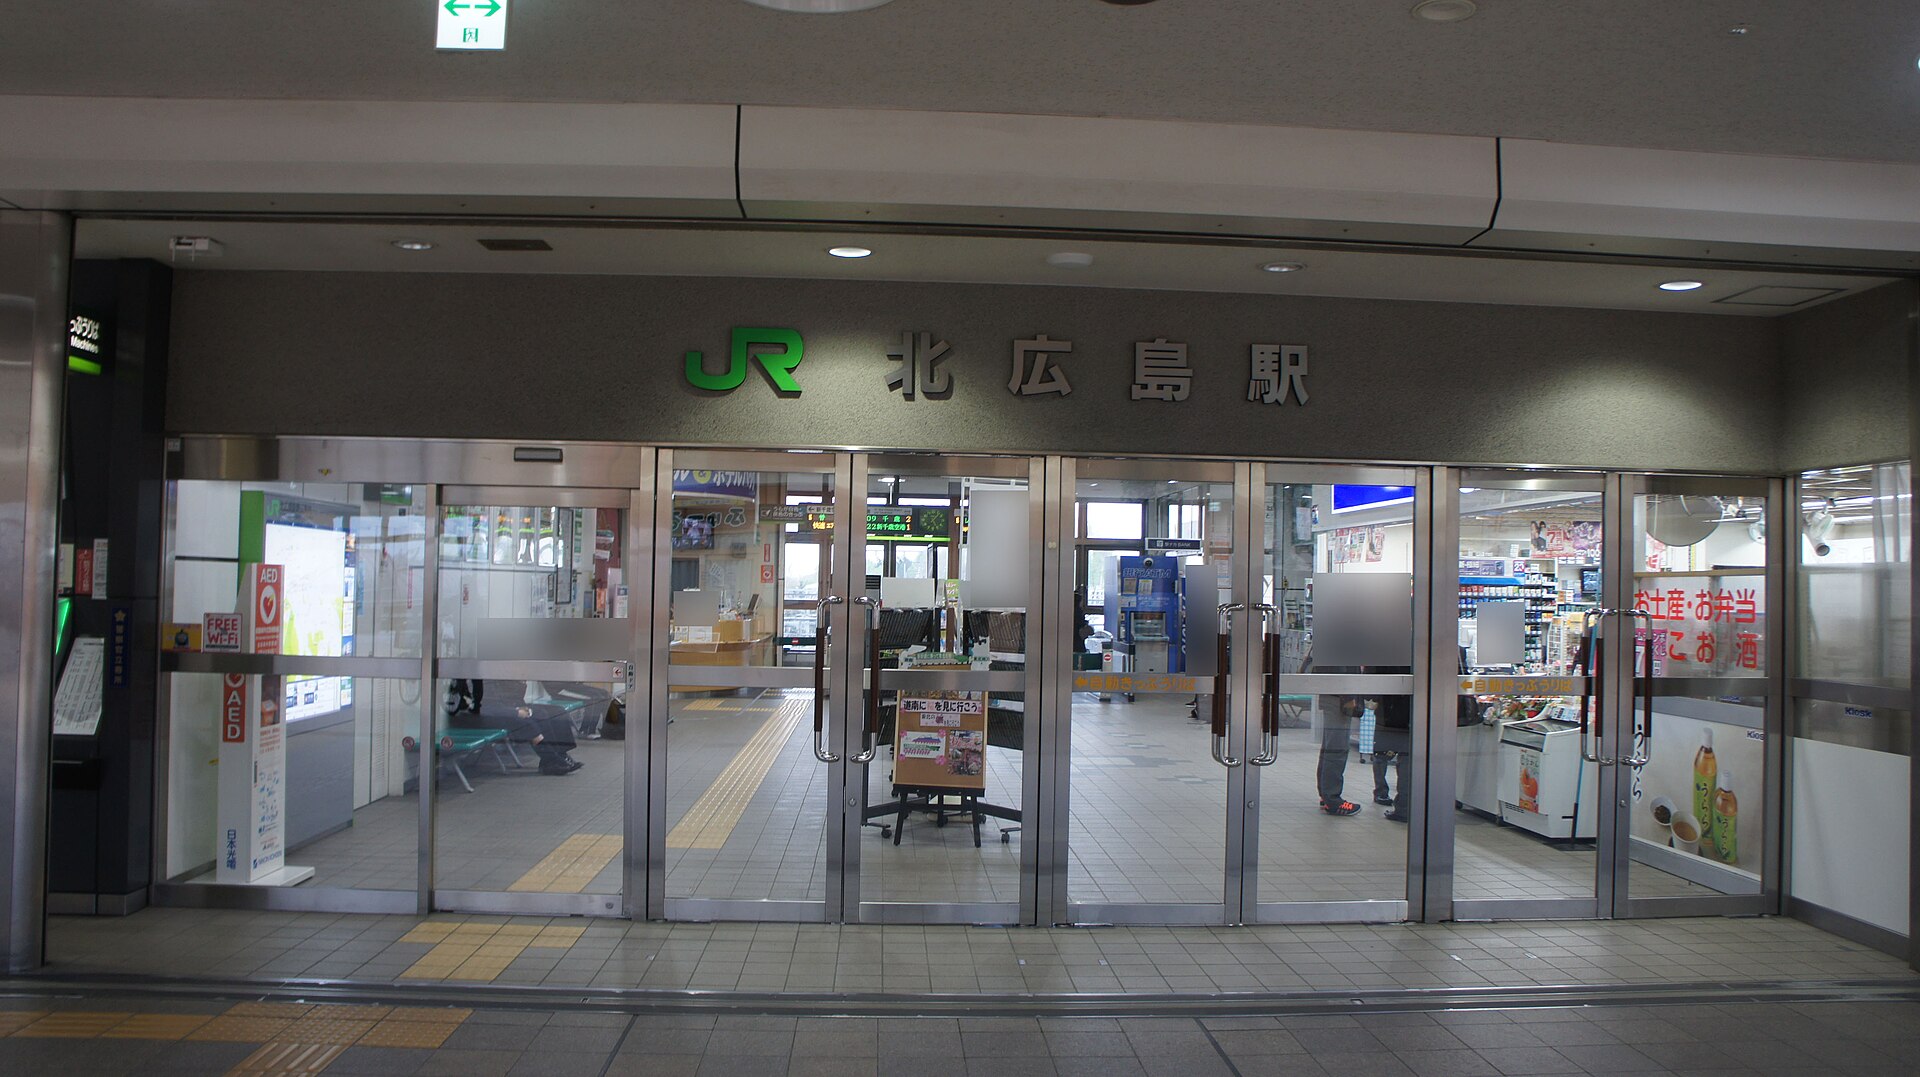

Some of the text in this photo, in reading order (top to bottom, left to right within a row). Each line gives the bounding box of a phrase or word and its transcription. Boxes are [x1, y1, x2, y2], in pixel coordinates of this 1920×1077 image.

[70, 335, 98, 354] Machines
[686, 327, 1310, 404] JR 北広島駅
[260, 568, 278, 583] AED
[1634, 588, 1757, 624] お土産・お弁当
[207, 619, 238, 631] FREE
[207, 632, 239, 645] Wi-Fi
[1090, 676, 1196, 691] 自動きっぷうりば
[1474, 679, 1573, 693] 自動きっぷうりば
[226, 691, 241, 740] AED
[1844, 707, 1872, 718] Kiosk
[226, 829, 237, 869] 日本光電
